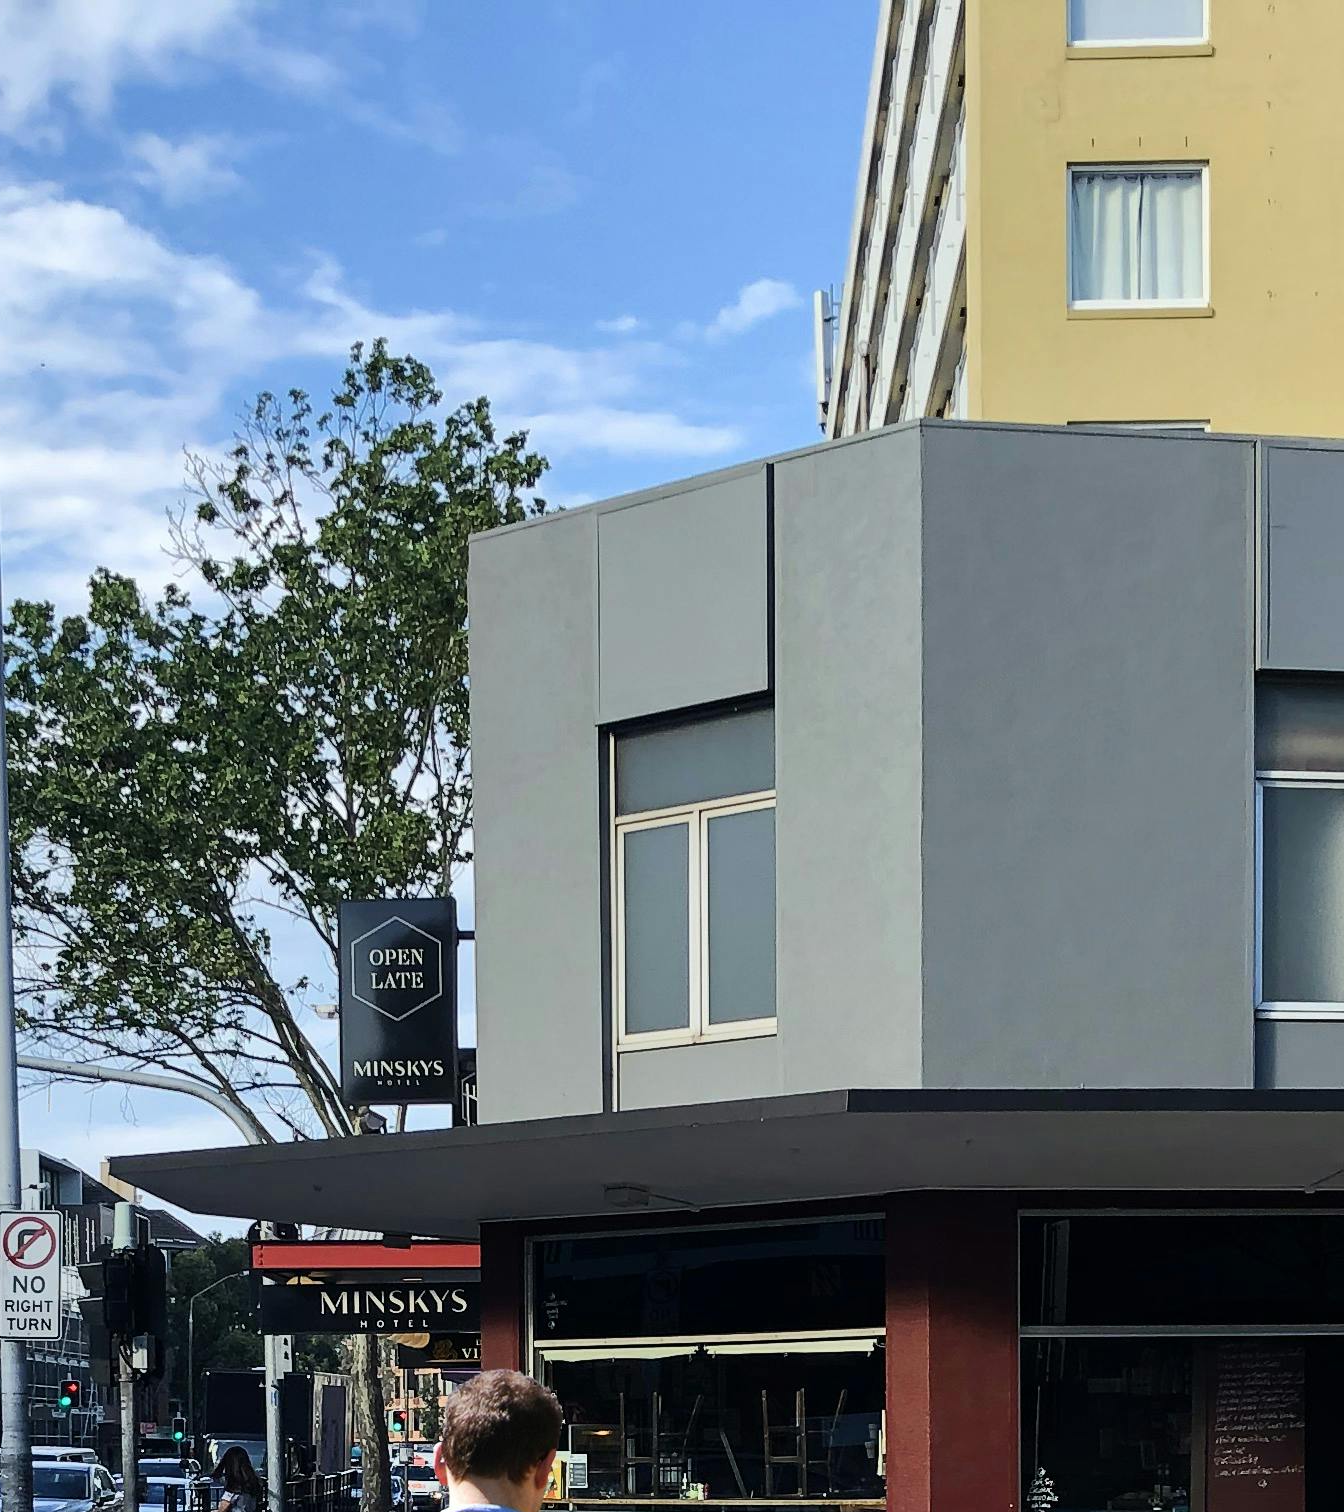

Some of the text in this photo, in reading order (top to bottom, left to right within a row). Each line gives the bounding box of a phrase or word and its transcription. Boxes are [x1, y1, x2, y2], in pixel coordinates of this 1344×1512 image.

[368, 949, 425, 967] OPEN
[370, 972, 424, 989] LATE
[353, 1060, 444, 1077] MINSKYS
[13, 1275, 46, 1294] NO
[4, 1300, 54, 1313] RIGHT
[320, 1288, 469, 1315] MINSKYS
[6, 1317, 52, 1331] TURN
[360, 1319, 429, 1328] HOTEL
[461, 1347, 481, 1359] VI
